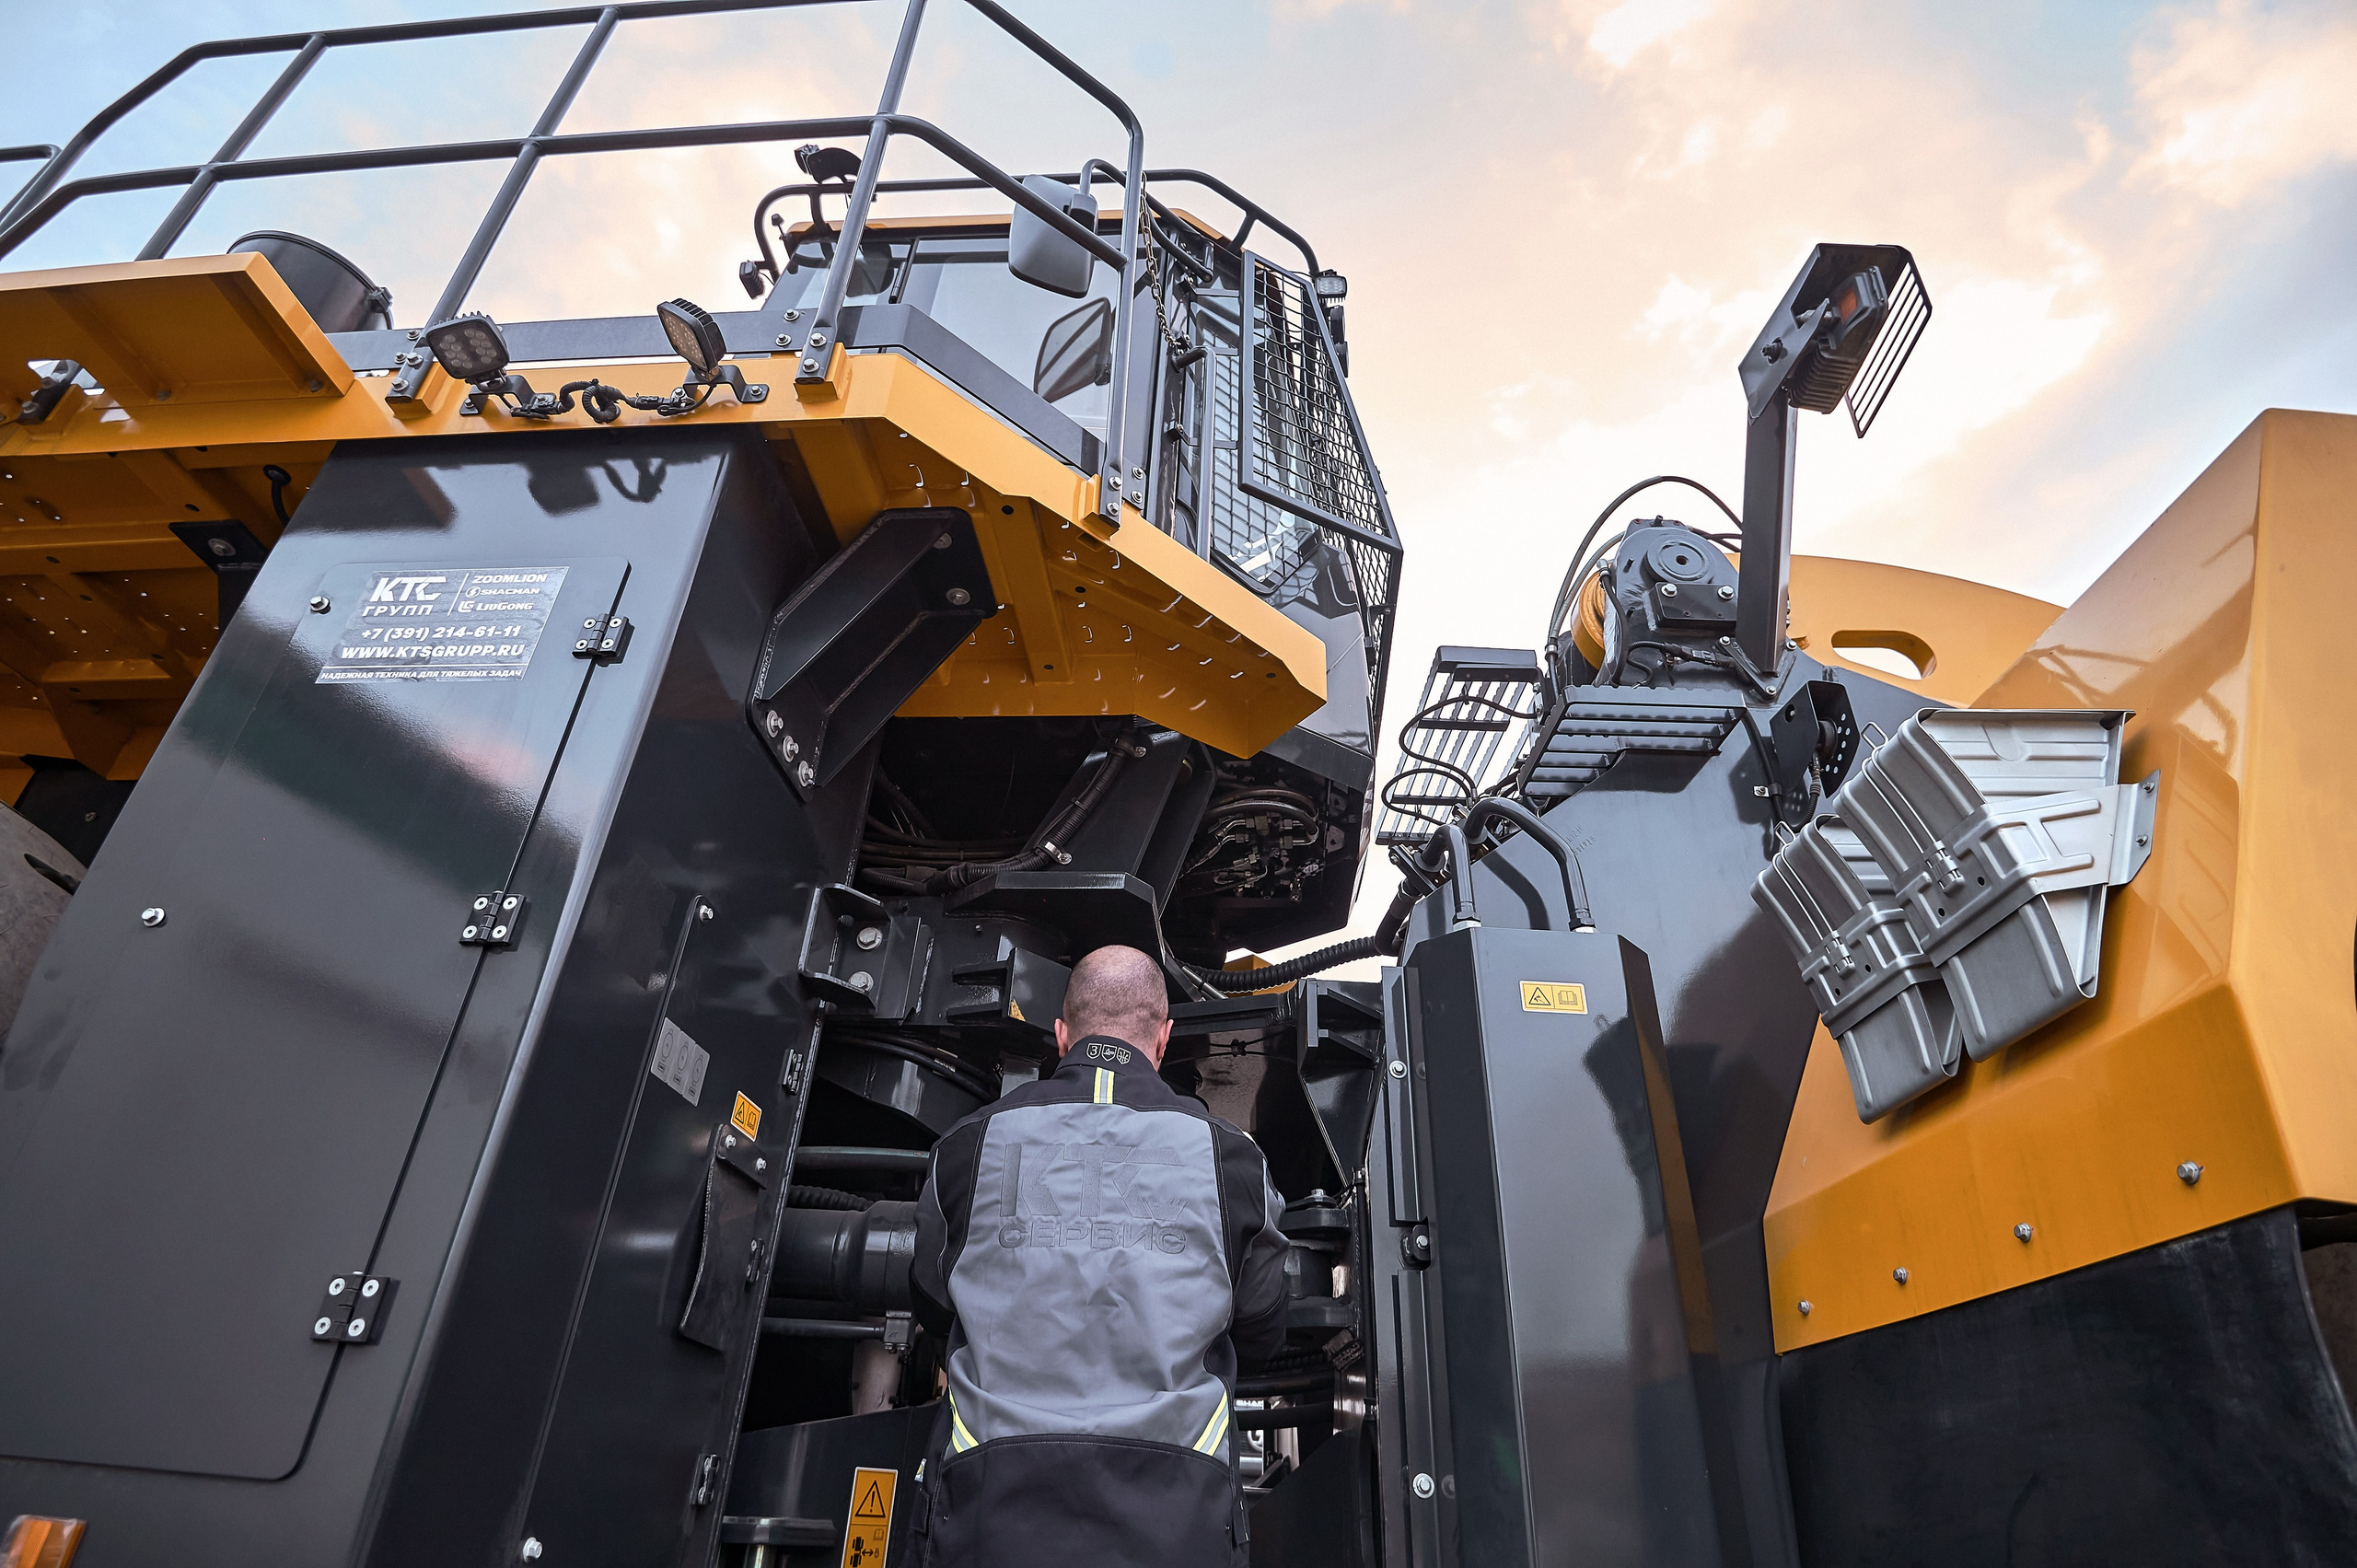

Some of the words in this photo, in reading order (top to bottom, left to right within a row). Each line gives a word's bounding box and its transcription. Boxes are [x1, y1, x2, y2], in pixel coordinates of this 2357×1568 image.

[471, 574, 548, 584] ZOOMLION
[370, 576, 447, 602] КТС
[362, 604, 435, 617] ГРУПП
[361, 628, 384, 640] +7
[384, 627, 430, 643] (391)
[432, 625, 522, 638] 214-61-11
[341, 644, 526, 659] WWW.KTSGRUPP.RU
[320, 671, 374, 680] НАДЕЖНАЯ
[375, 671, 417, 679] ТЕХНИКА
[417, 670, 440, 679] ДЛЯ
[440, 669, 488, 679] ТЯЖЕЛЫХ
[488, 669, 523, 678] ЗАДАЧ
[999, 1143, 1190, 1223] КТС
[998, 1221, 1187, 1255] СЕРВИС
